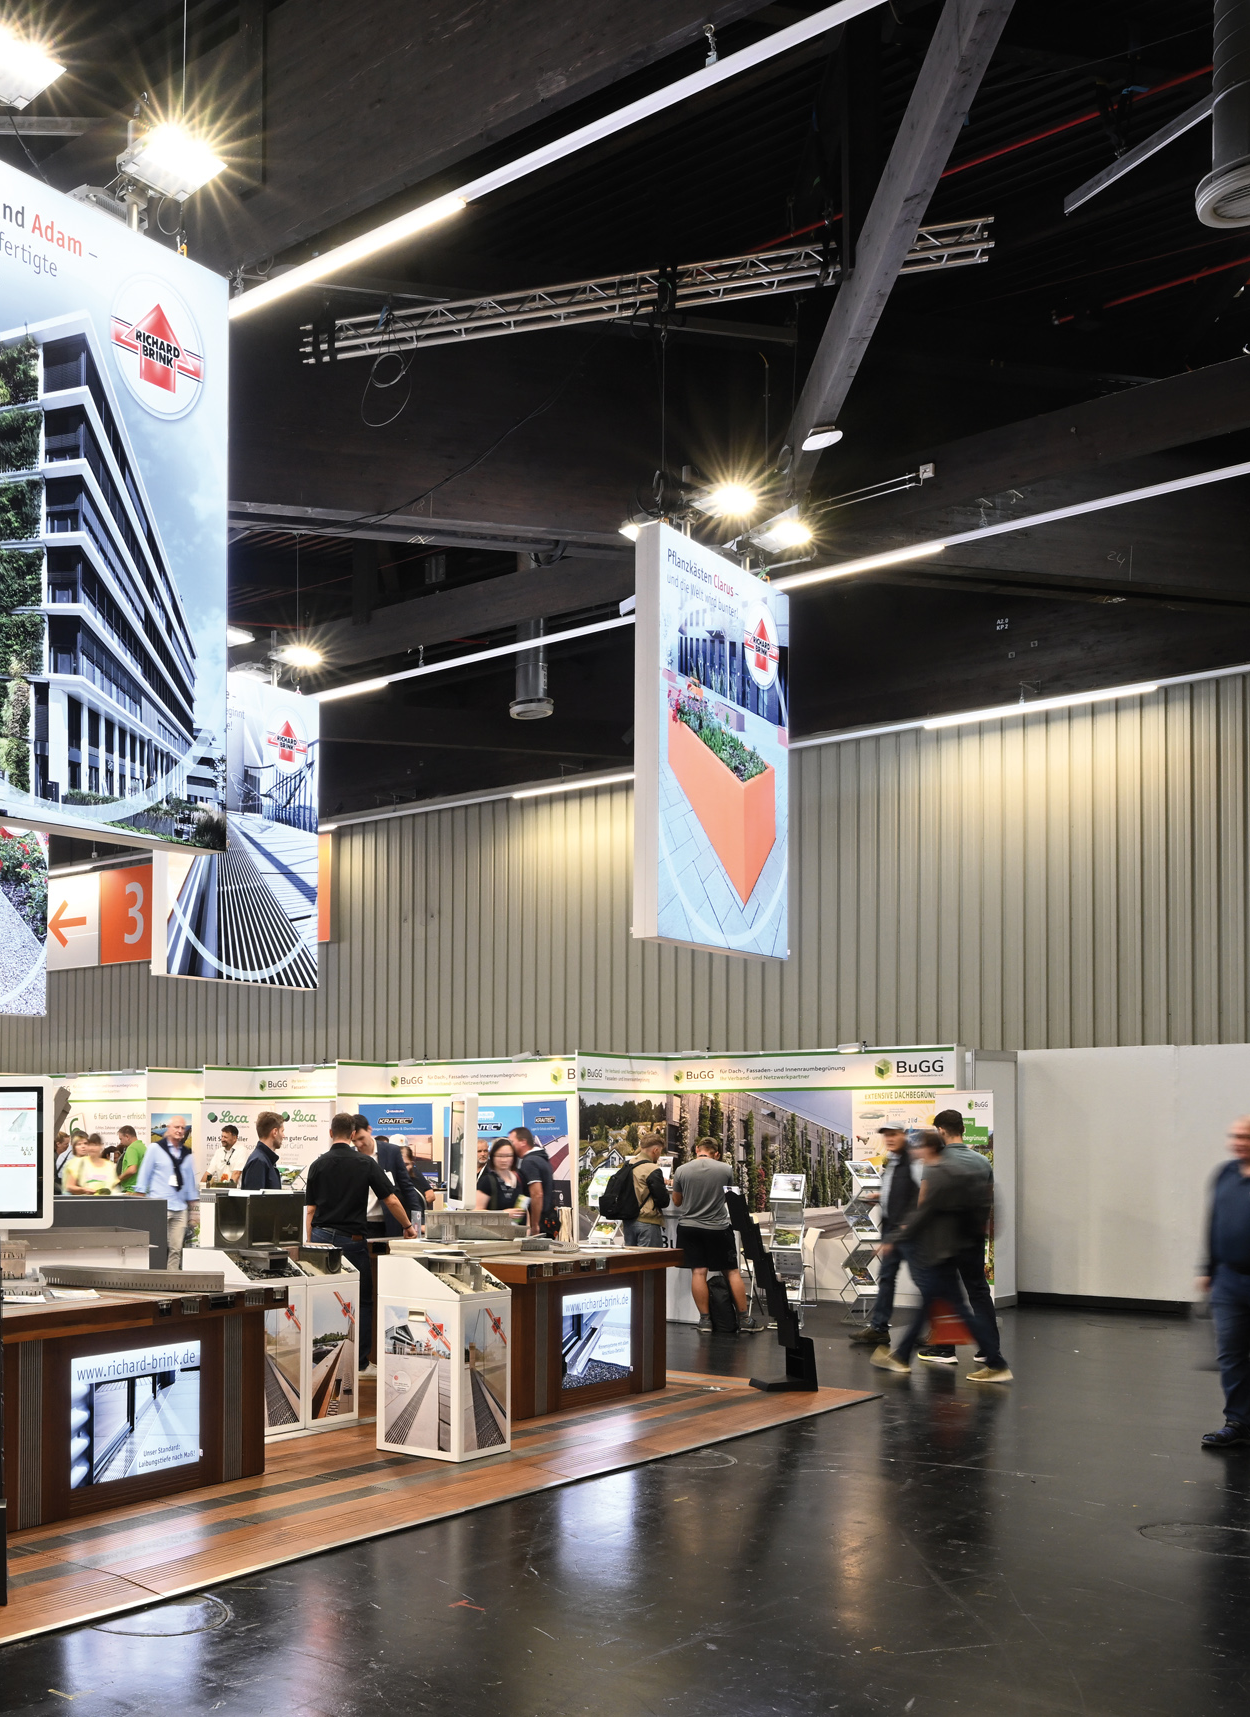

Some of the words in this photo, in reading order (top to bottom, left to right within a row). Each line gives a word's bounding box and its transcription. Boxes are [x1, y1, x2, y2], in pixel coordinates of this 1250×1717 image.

[31, 214, 83, 257] Adam
[135, 328, 181, 360] RICHARD
[142, 346, 174, 368] BRINK
[667, 548, 712, 586] Pflanzkästen
[713, 574, 734, 597] Clarus
[667, 573, 679, 589] und
[753, 635, 770, 651] RICHARD
[277, 735, 297, 746] RICHARD
[279, 742, 294, 751] BRINK
[123, 881, 145, 946] 3
[587, 1068, 603, 1078] BuGG
[785, 1065, 846, 1073] Innenraumbegrünung
[896, 1060, 944, 1073] BuGG
[686, 1070, 714, 1080] BuGG
[268, 1080, 287, 1088] BuGG
[109, 1112, 121, 1120] Grün
[219, 1110, 249, 1123] Leca
[291, 1109, 317, 1122] Leca
[565, 1293, 629, 1312] www.richard-brink.de
[77, 1349, 196, 1381] www.richard-brink.de
[143, 1448, 157, 1457] Unser
[158, 1444, 181, 1454] Standard:
[138, 1455, 171, 1468] Laibungstiefe
[172, 1453, 183, 1461] nach
[183, 1450, 196, 1459] Maß!
